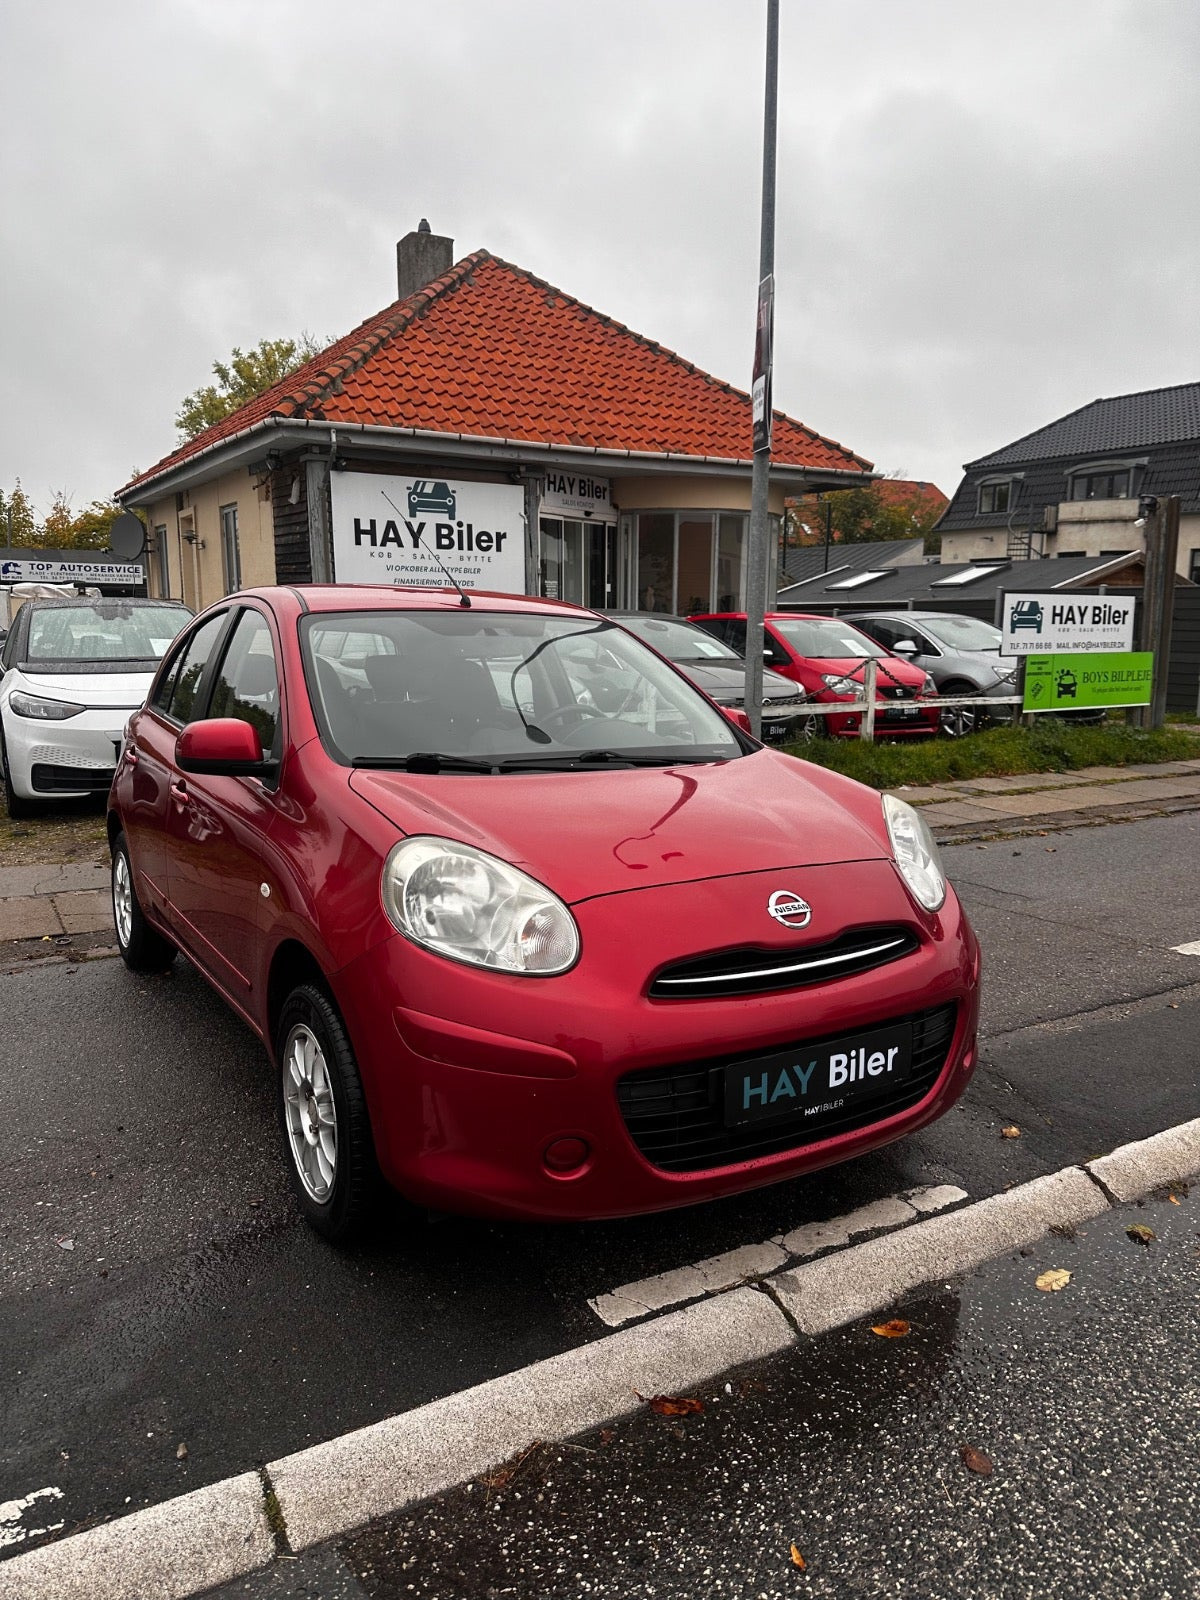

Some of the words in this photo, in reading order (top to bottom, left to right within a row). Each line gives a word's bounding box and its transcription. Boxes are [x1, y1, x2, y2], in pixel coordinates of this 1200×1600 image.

[546, 473, 576, 495] HAY
[578, 478, 608, 500] Biler
[353, 517, 427, 549] HAY
[435, 521, 507, 553] Biler
[370, 551, 392, 559] KØB
[412, 553, 441, 561] SALG
[459, 555, 492, 563] BYTTE
[28, 562, 53, 571] TOP
[60, 564, 141, 574] AUTOSERVICE
[386, 564, 394, 572] VI
[394, 564, 428, 573] OPKØBER
[393, 578, 443, 586] FINANSIERING
[1051, 605, 1089, 625] HAY
[1091, 603, 1129, 625] Biler
[1082, 670, 1108, 684] BOYS
[1111, 669, 1152, 683] BILPLEJE
[770, 726, 786, 734] Biler
[774, 902, 810, 915] NISSAN
[742, 1060, 817, 1109] HAY
[828, 1046, 899, 1088] Biler
